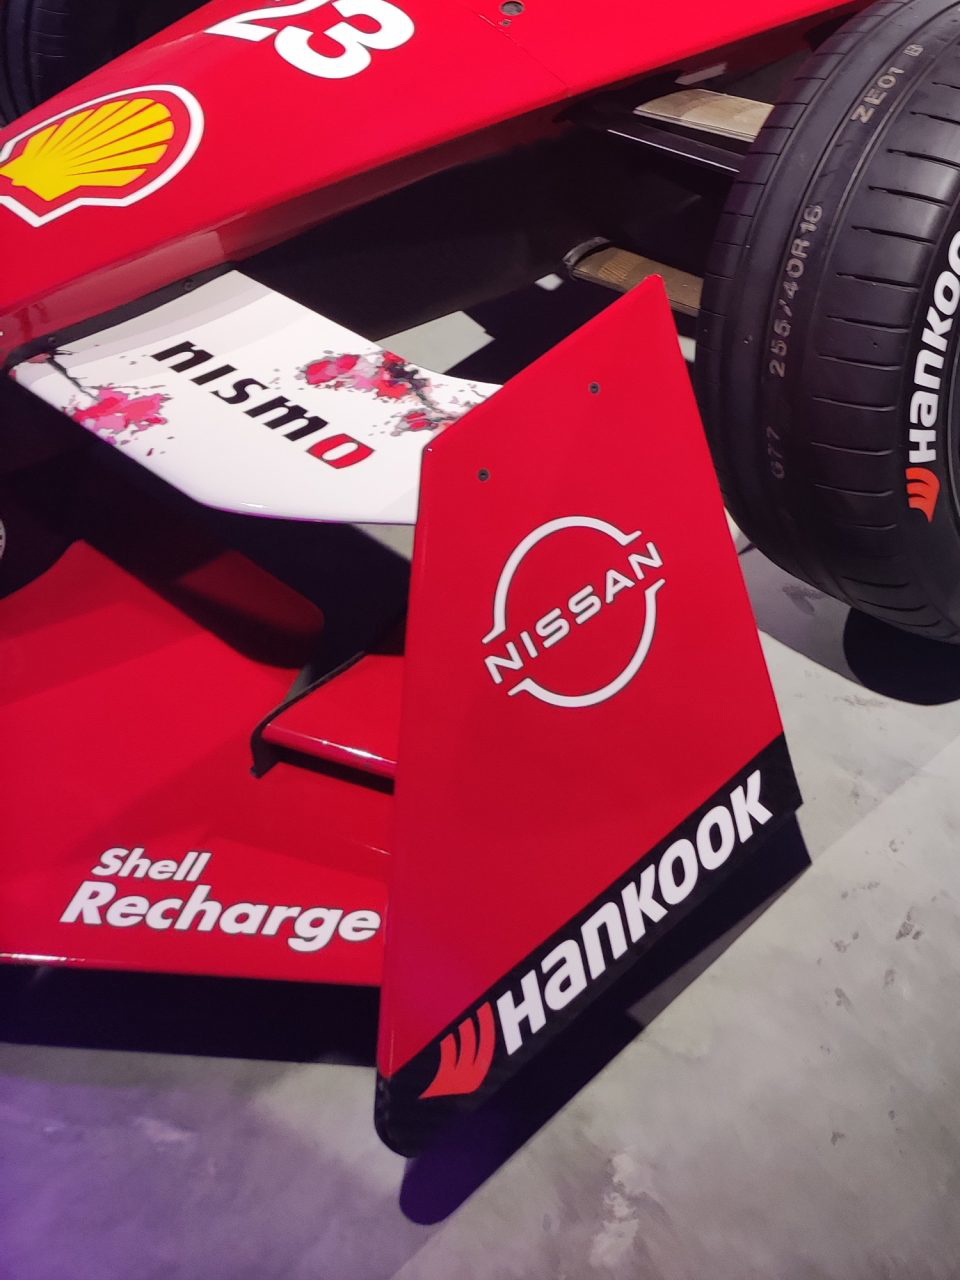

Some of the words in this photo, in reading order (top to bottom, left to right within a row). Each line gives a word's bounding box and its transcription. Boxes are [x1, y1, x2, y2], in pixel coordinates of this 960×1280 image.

[149, 340, 375, 469] nismo
[483, 541, 665, 685] NISSAN
[90, 846, 211, 883] Shell
[60, 879, 381, 954] Recharge
